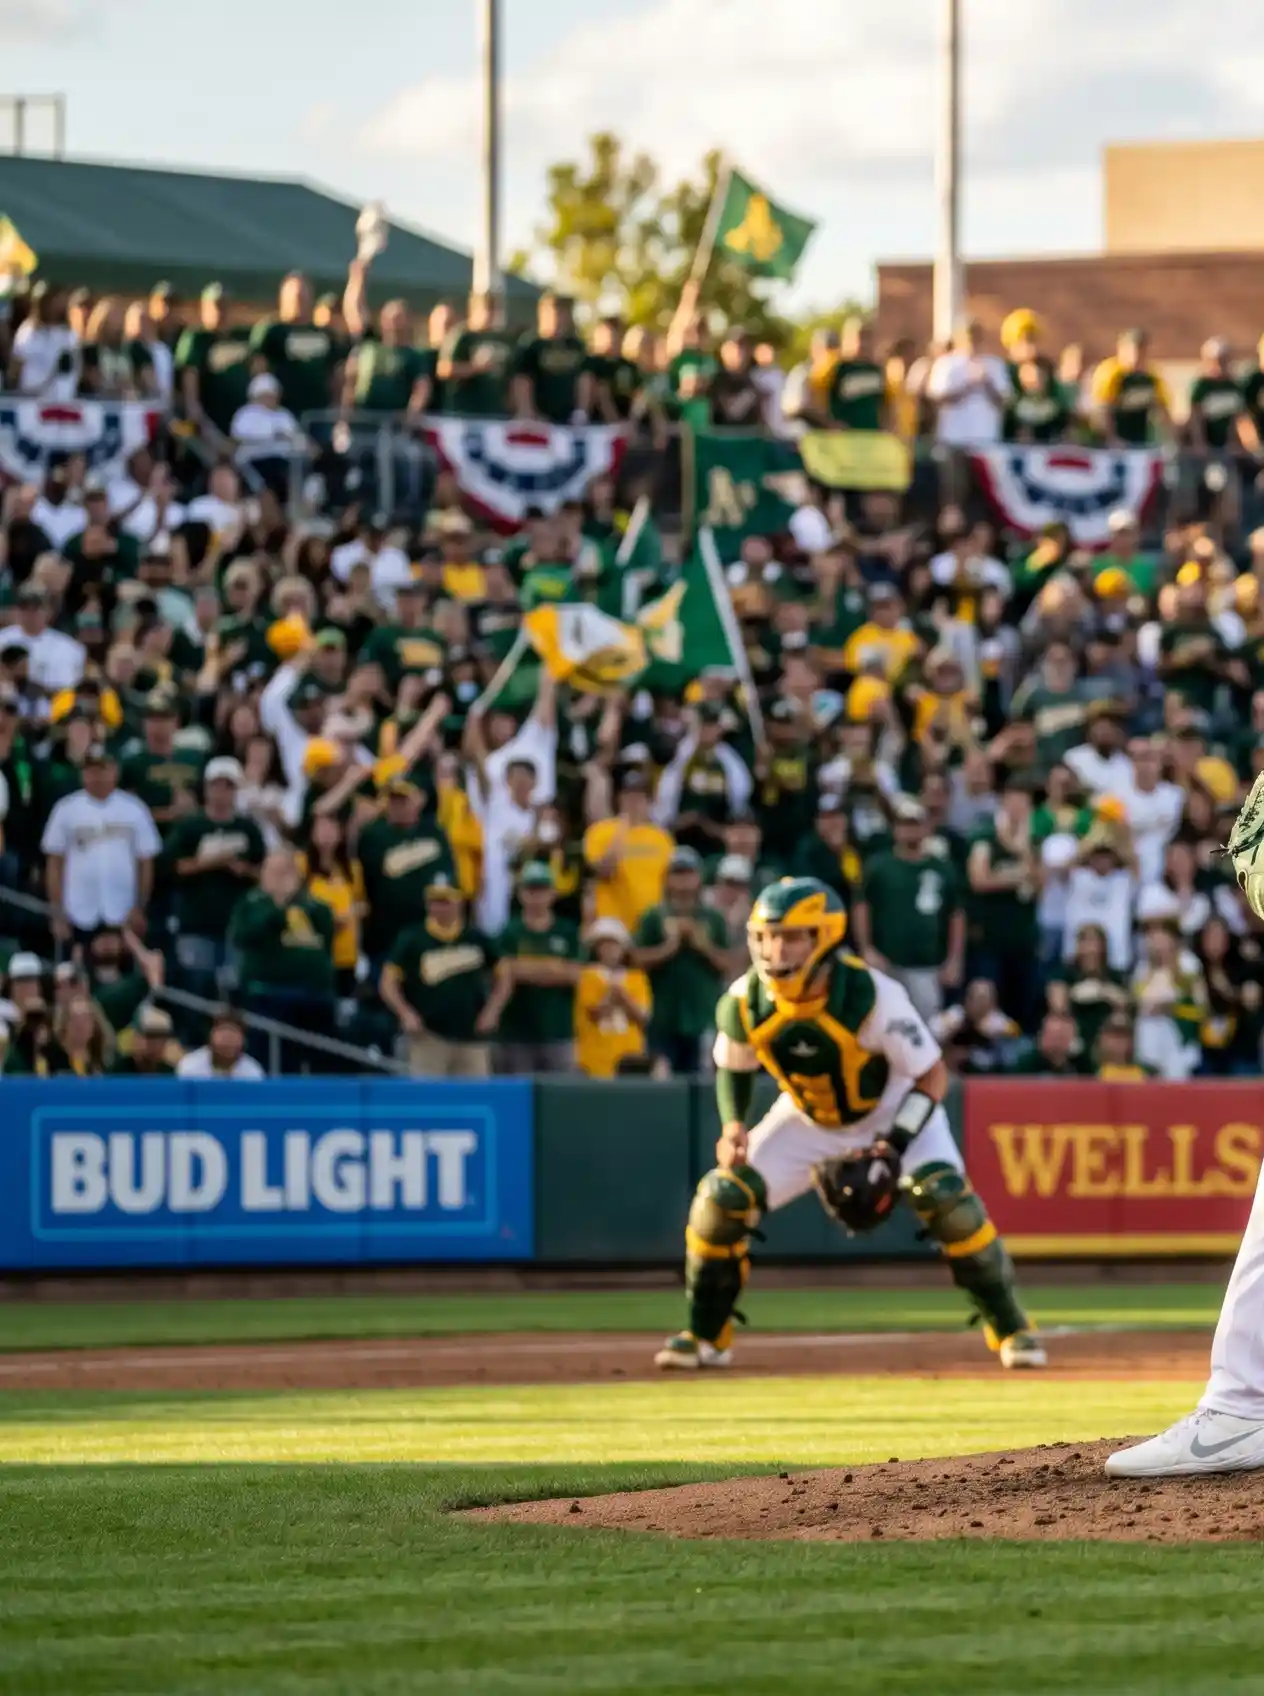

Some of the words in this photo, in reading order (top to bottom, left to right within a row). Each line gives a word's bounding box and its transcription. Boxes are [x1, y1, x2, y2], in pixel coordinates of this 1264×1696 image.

[50, 1131, 228, 1215] BUD
[239, 1128, 478, 1213] LIGHT
[988, 1122, 1261, 1198] WELLS
